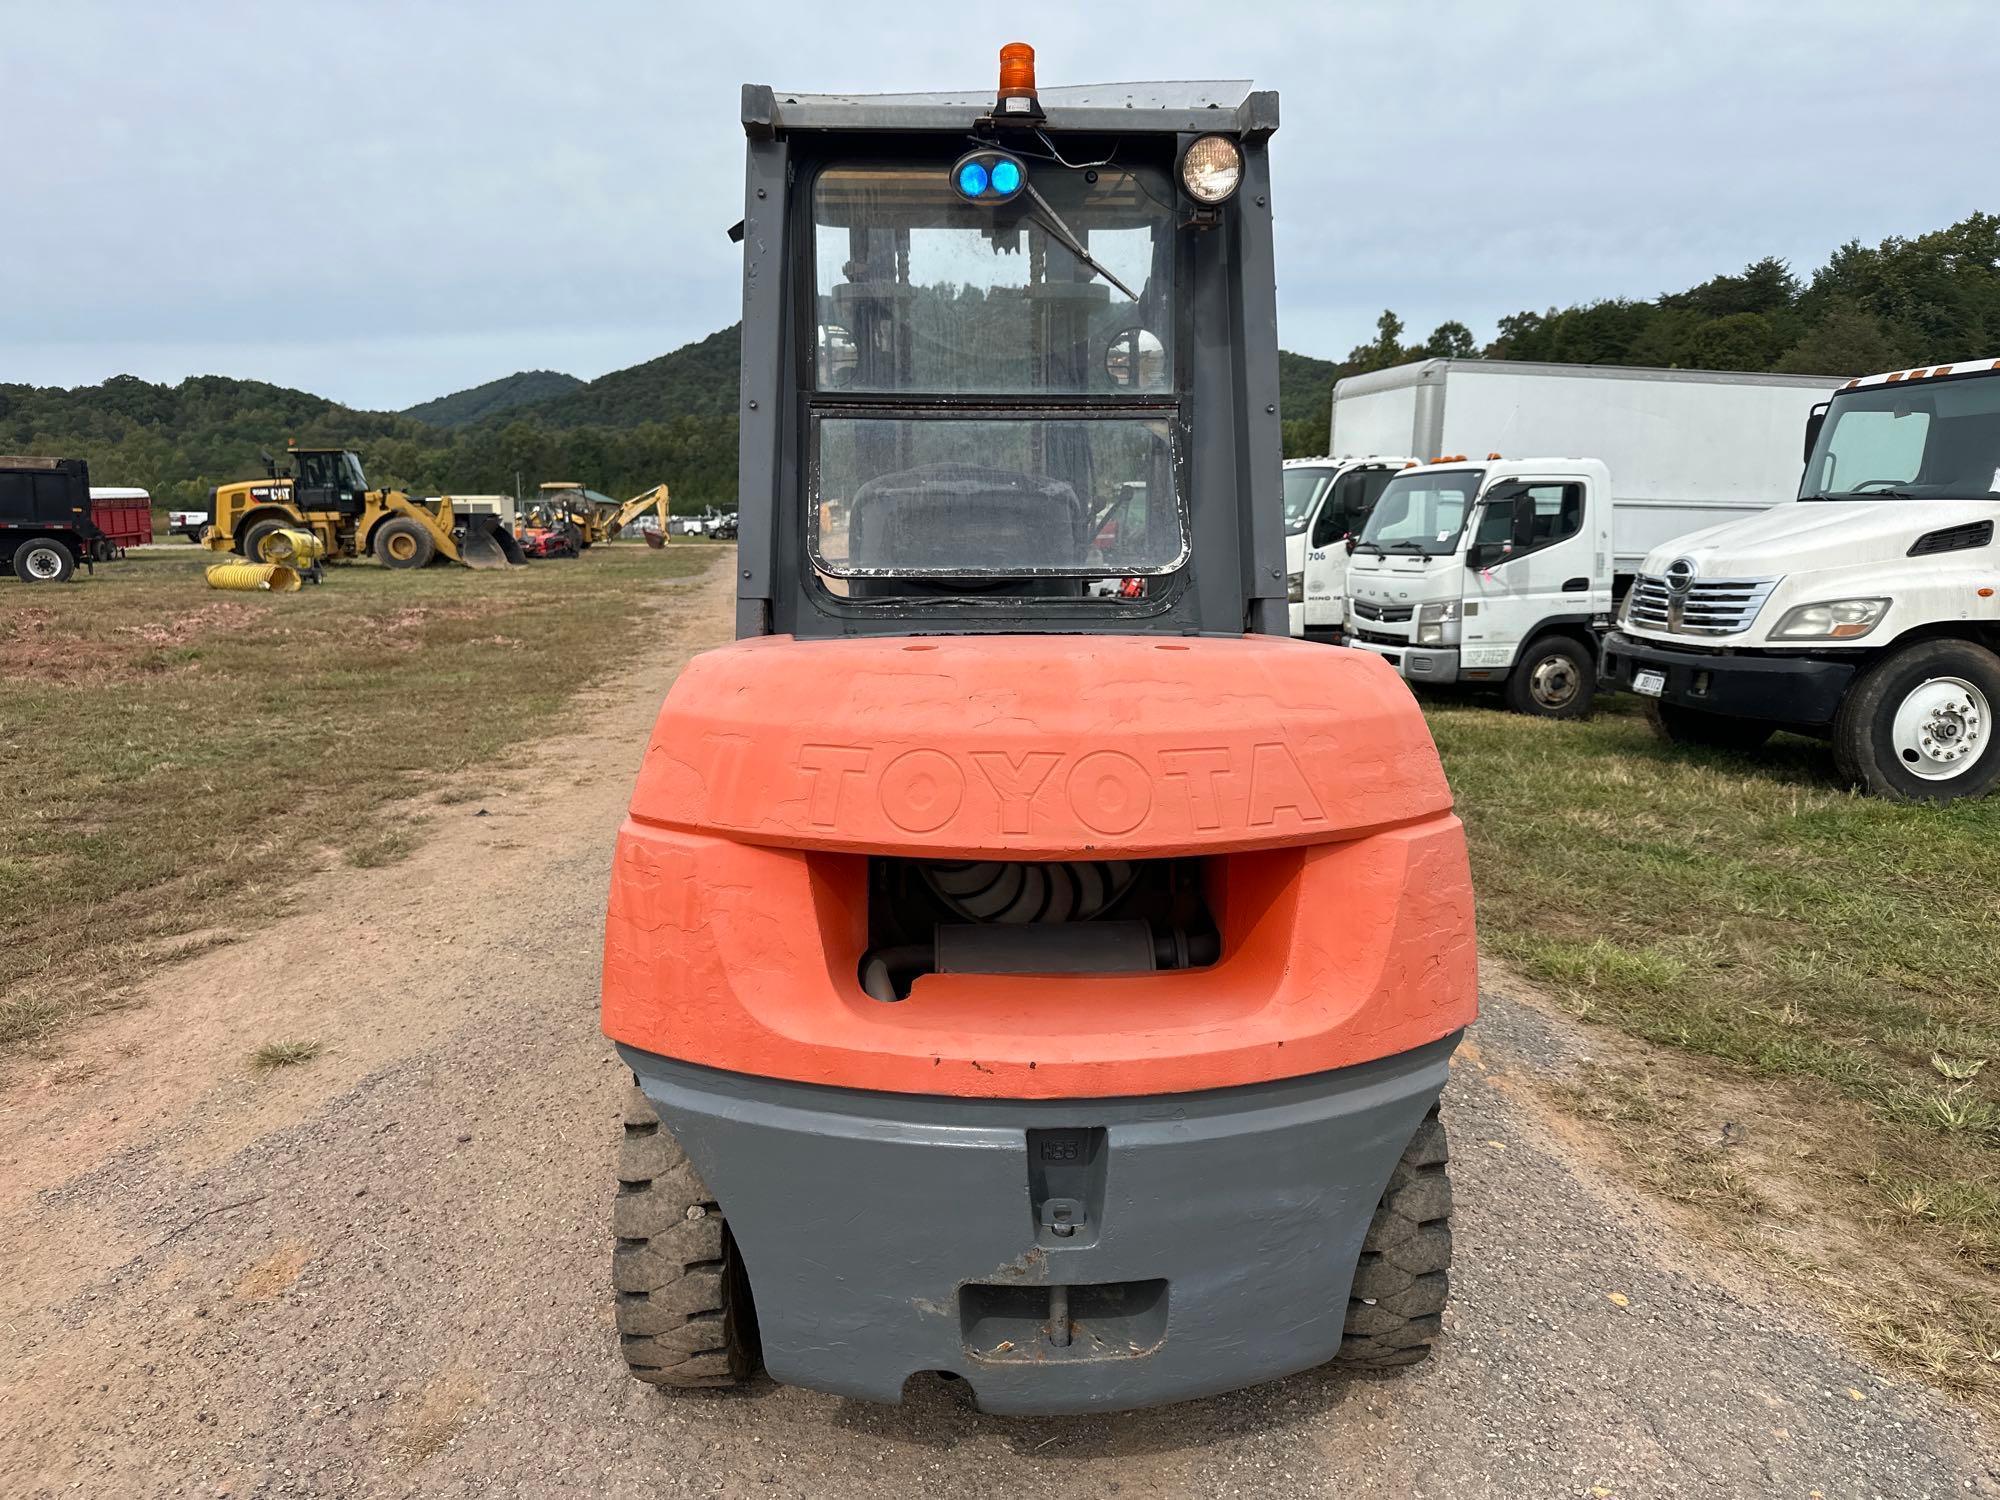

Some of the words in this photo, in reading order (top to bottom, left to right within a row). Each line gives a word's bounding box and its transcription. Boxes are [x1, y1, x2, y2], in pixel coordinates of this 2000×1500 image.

[271, 488, 290, 500] CAT
[1308, 552, 1326, 560] 706
[1357, 589, 1408, 598] FUSO
[800, 741, 1328, 836] TOYOTA
